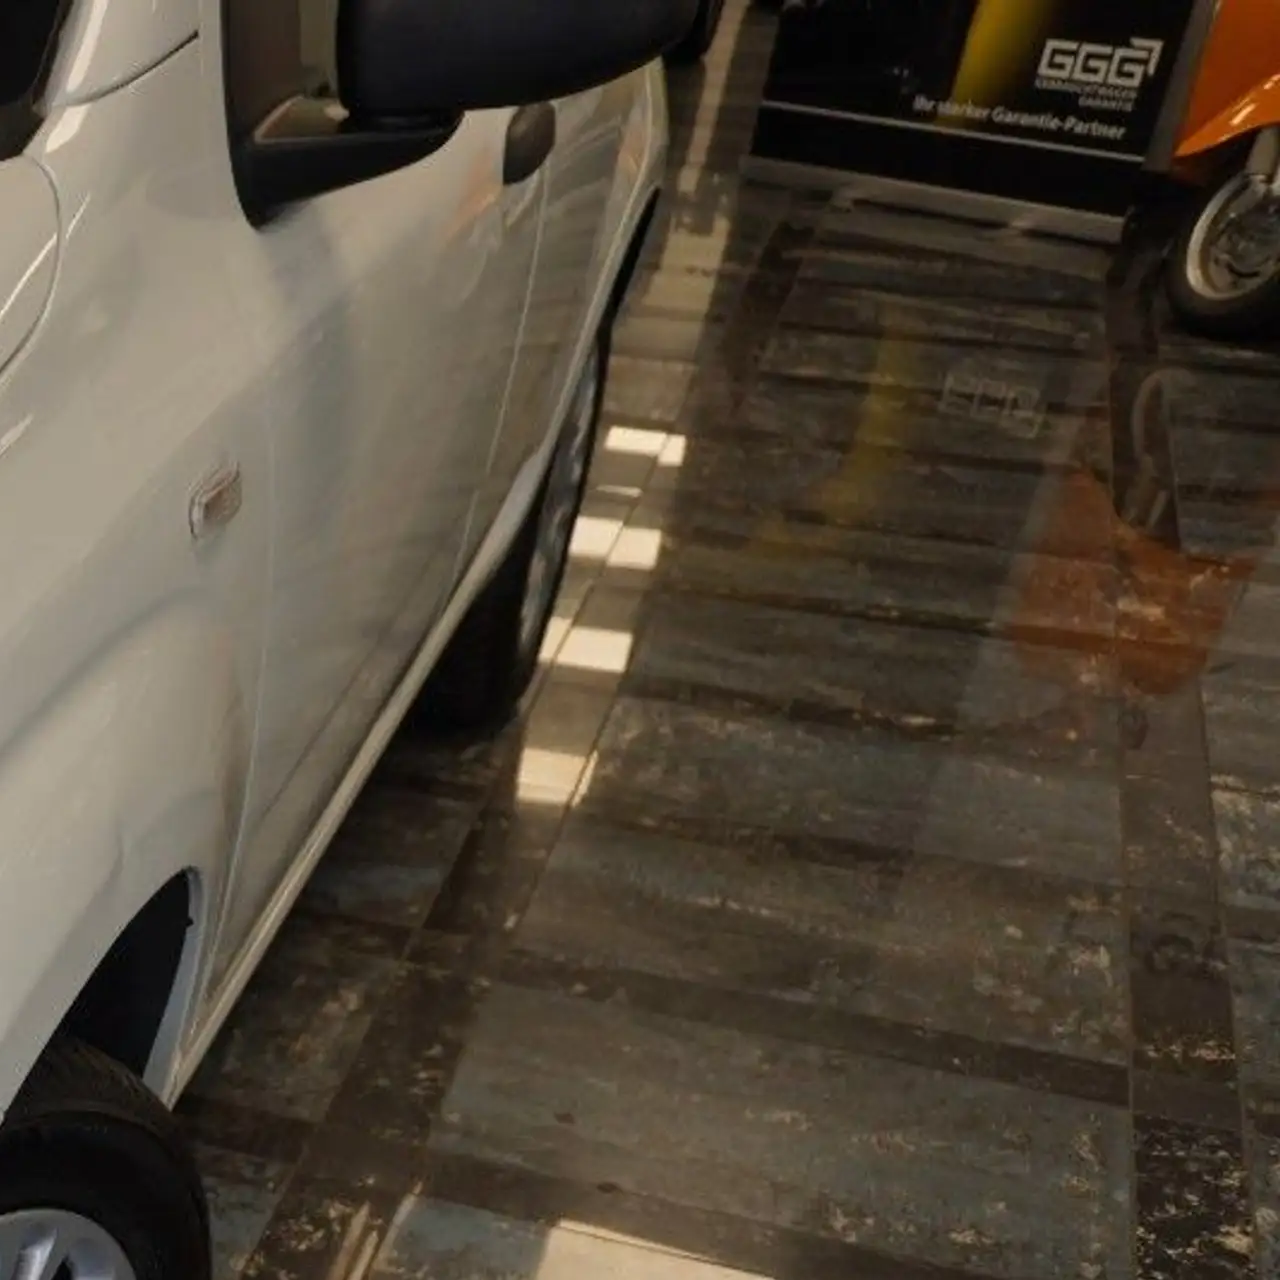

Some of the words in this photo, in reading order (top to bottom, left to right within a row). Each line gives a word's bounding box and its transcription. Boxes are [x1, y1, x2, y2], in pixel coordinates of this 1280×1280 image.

[913, 94, 936, 113] Ihr
[937, 97, 990, 118] starker
[991, 105, 1126, 140] Garantie-Partner
